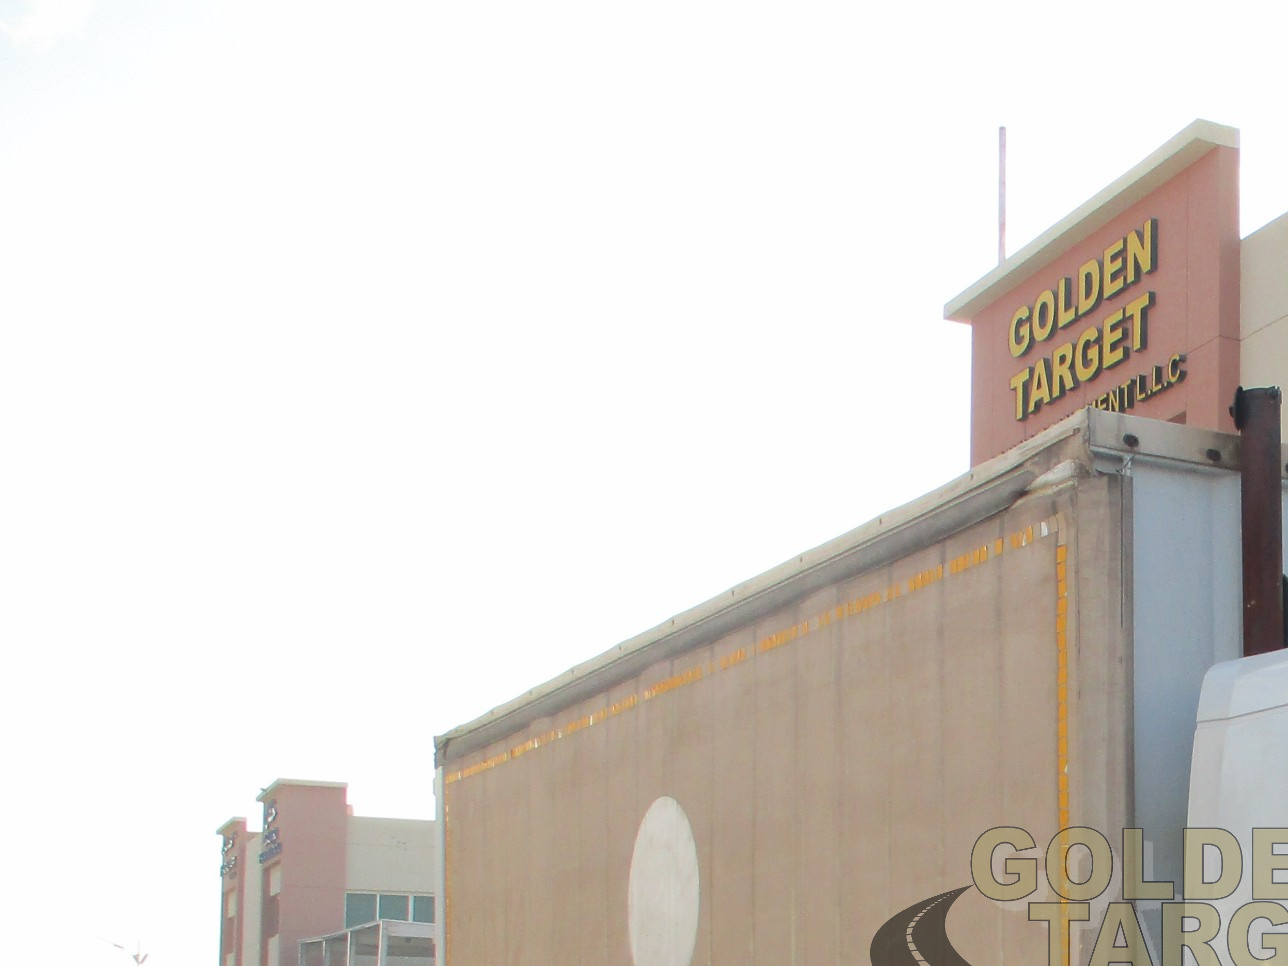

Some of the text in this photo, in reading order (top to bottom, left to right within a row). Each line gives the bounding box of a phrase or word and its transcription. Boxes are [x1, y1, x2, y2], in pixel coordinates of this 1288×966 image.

[1009, 218, 1155, 358] GOLDEN
[1010, 291, 1154, 421] TARGET
[1136, 354, 1186, 402] L.L.C
